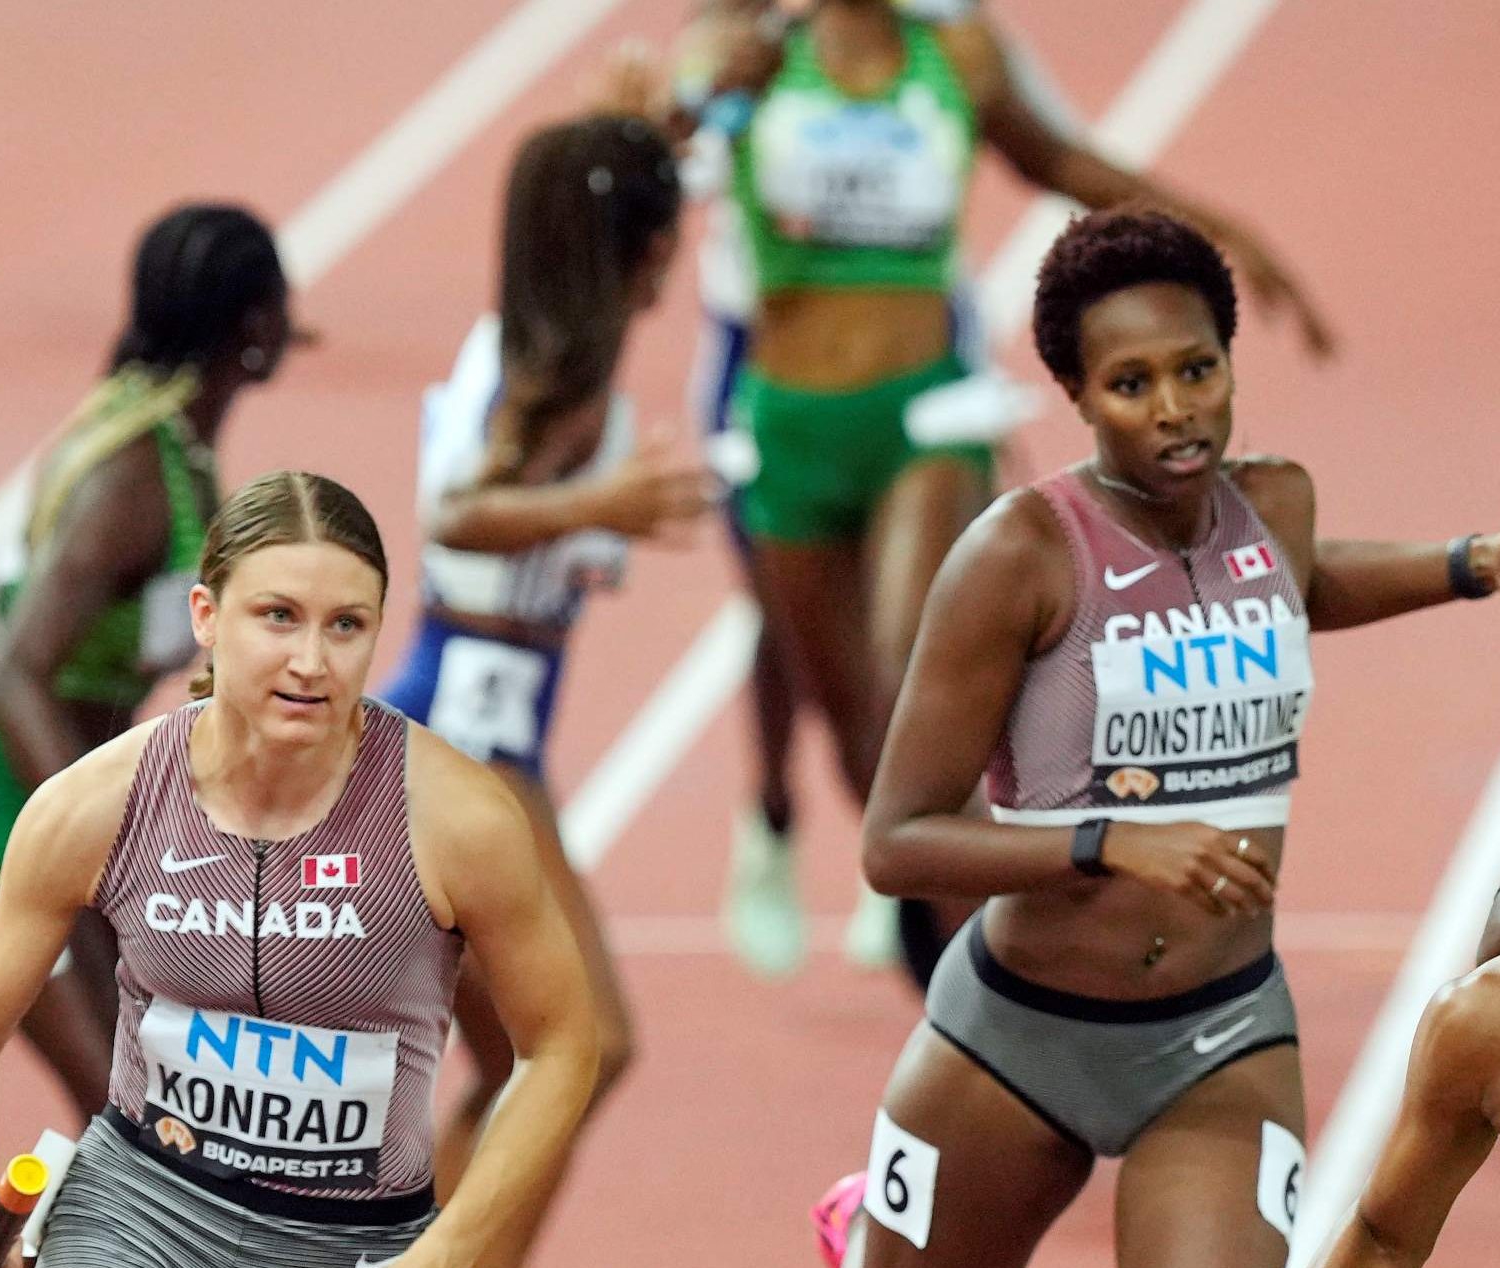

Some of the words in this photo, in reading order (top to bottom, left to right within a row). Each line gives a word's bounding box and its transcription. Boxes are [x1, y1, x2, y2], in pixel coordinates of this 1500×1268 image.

[1104, 595, 1293, 644] CANADA
[1142, 628, 1277, 694] NTN
[145, 892, 367, 940] CANADA
[186, 1010, 348, 1087] NTN
[157, 1062, 369, 1145] KONRAD
[202, 1140, 332, 1178] BUDAPEST
[333, 1157, 364, 1177] 23
[883, 1149, 910, 1213] 6
